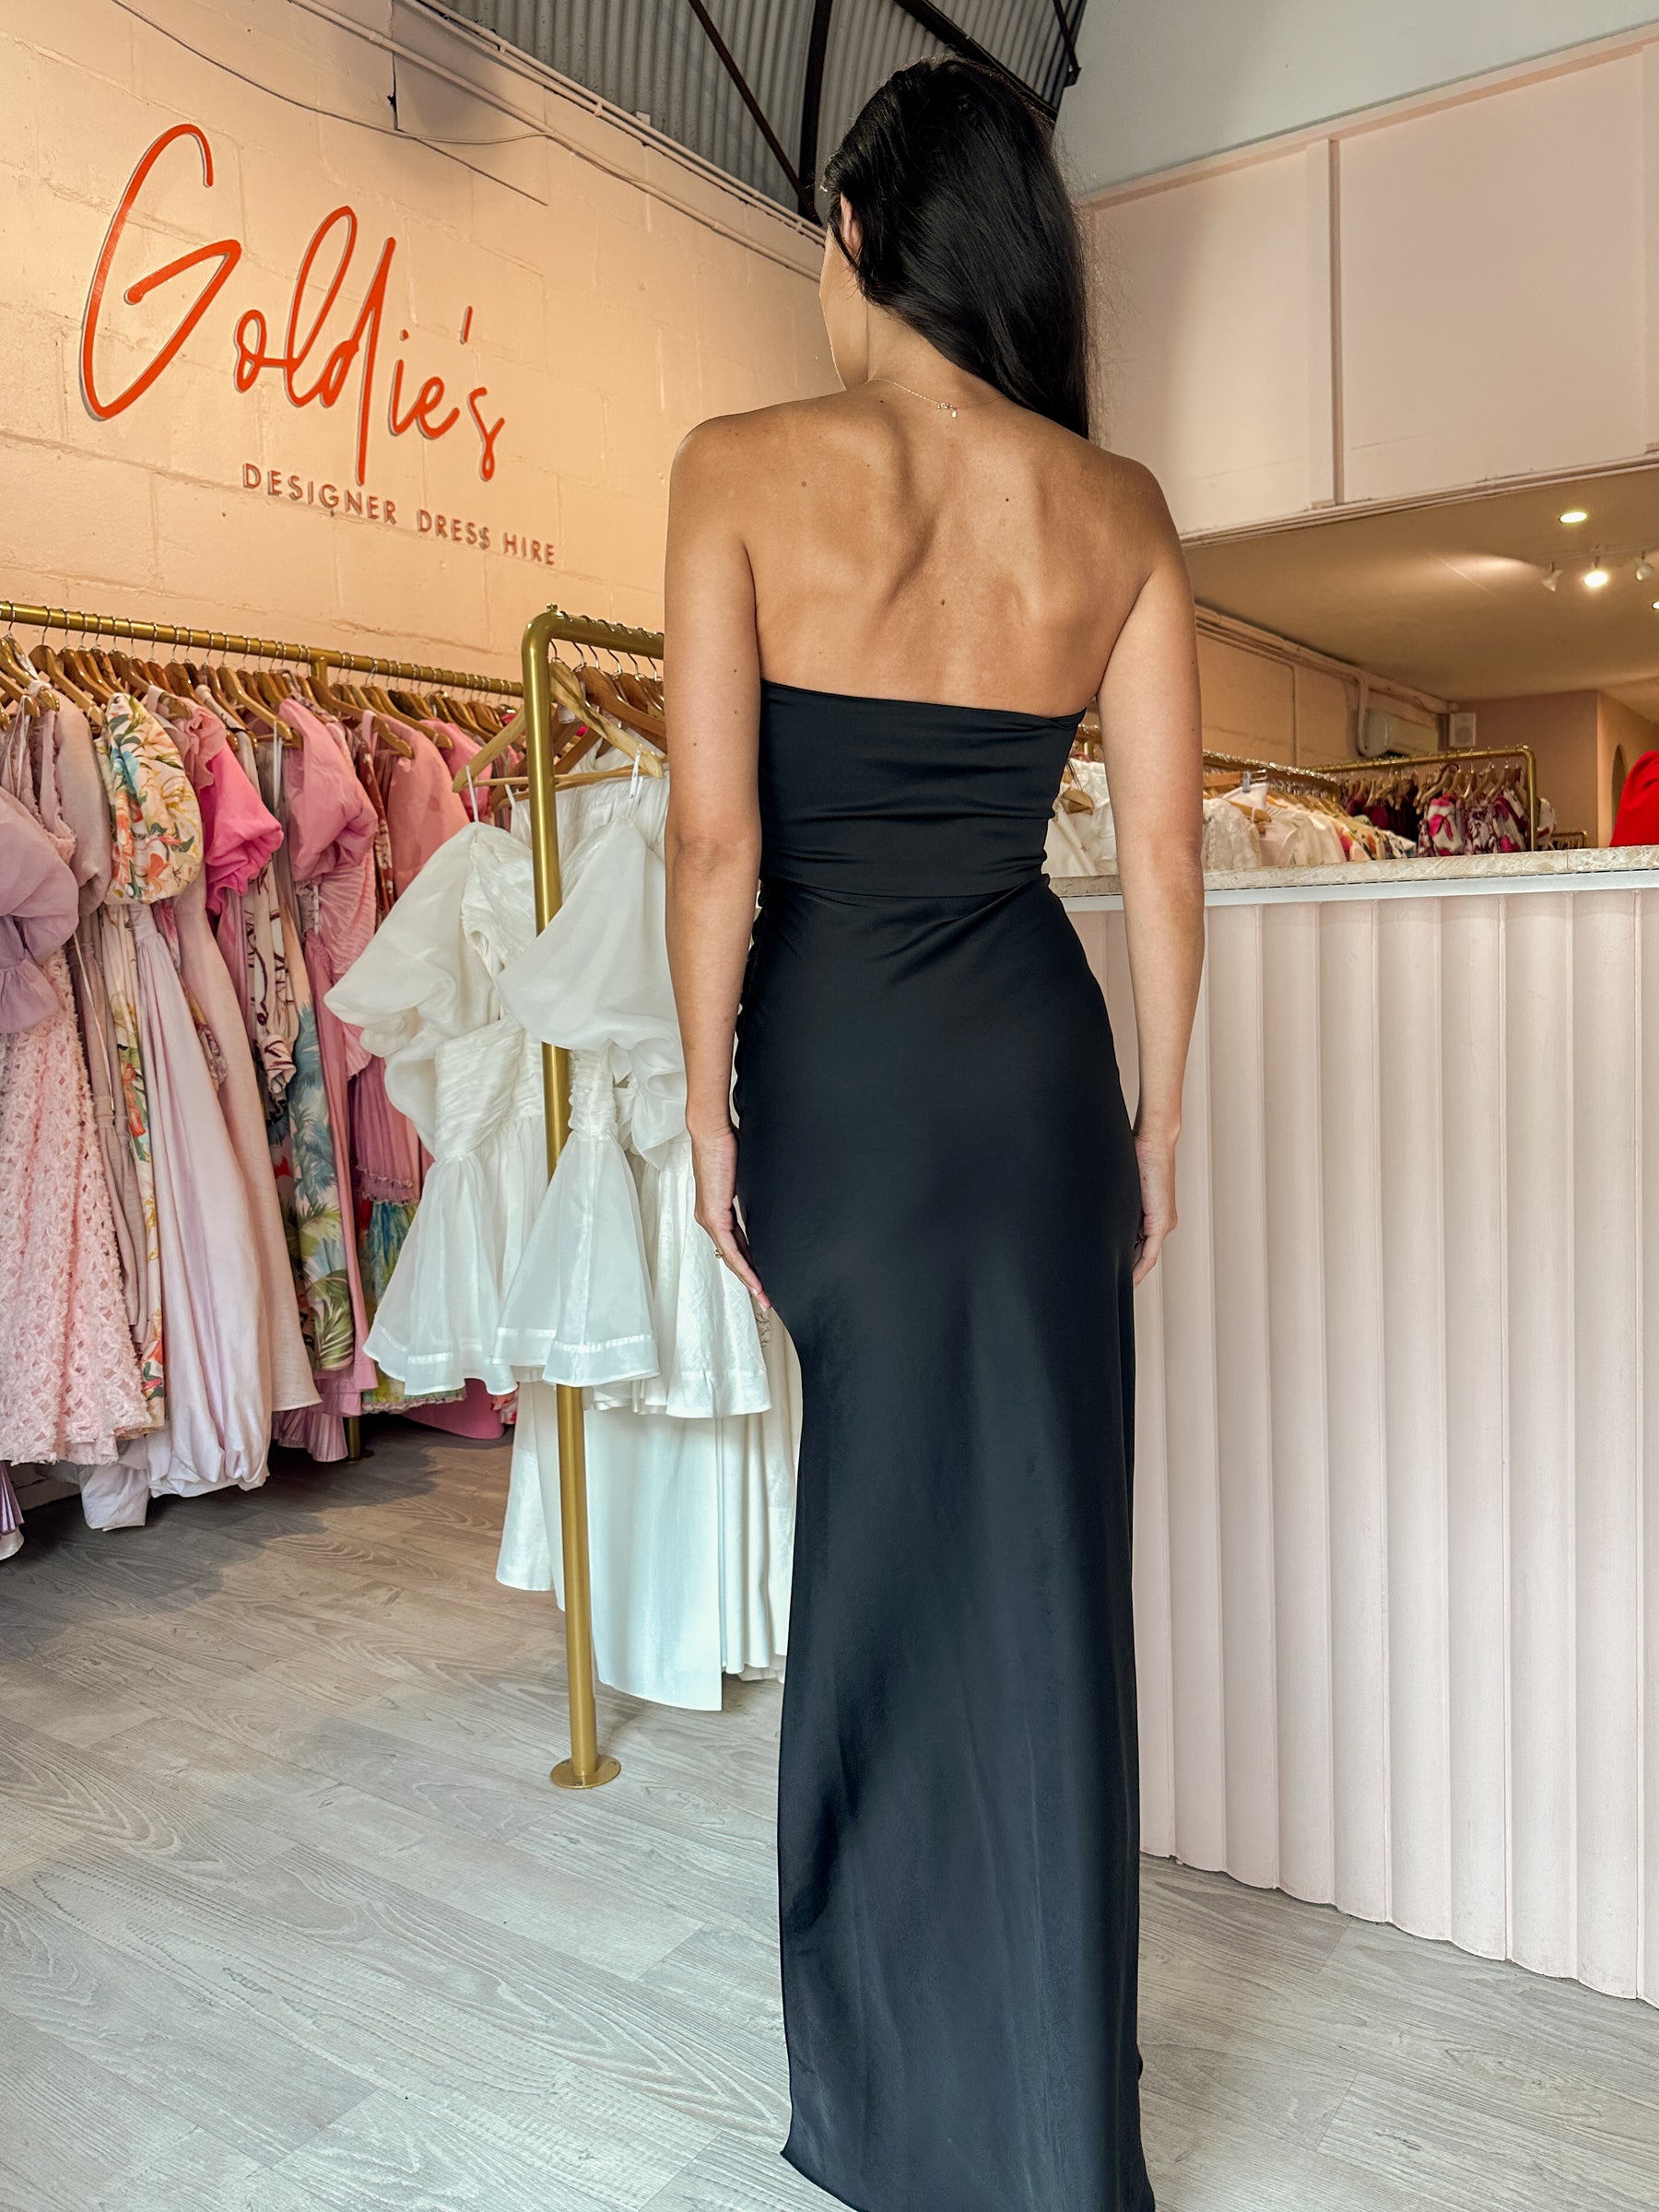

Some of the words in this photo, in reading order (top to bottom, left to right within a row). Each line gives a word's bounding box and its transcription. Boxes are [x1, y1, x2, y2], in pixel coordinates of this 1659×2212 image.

[82, 123, 505, 485] Goldie's
[241, 463, 396, 524] DESIGNER
[416, 510, 490, 550] DRESS
[503, 533, 556, 566] HIRE
